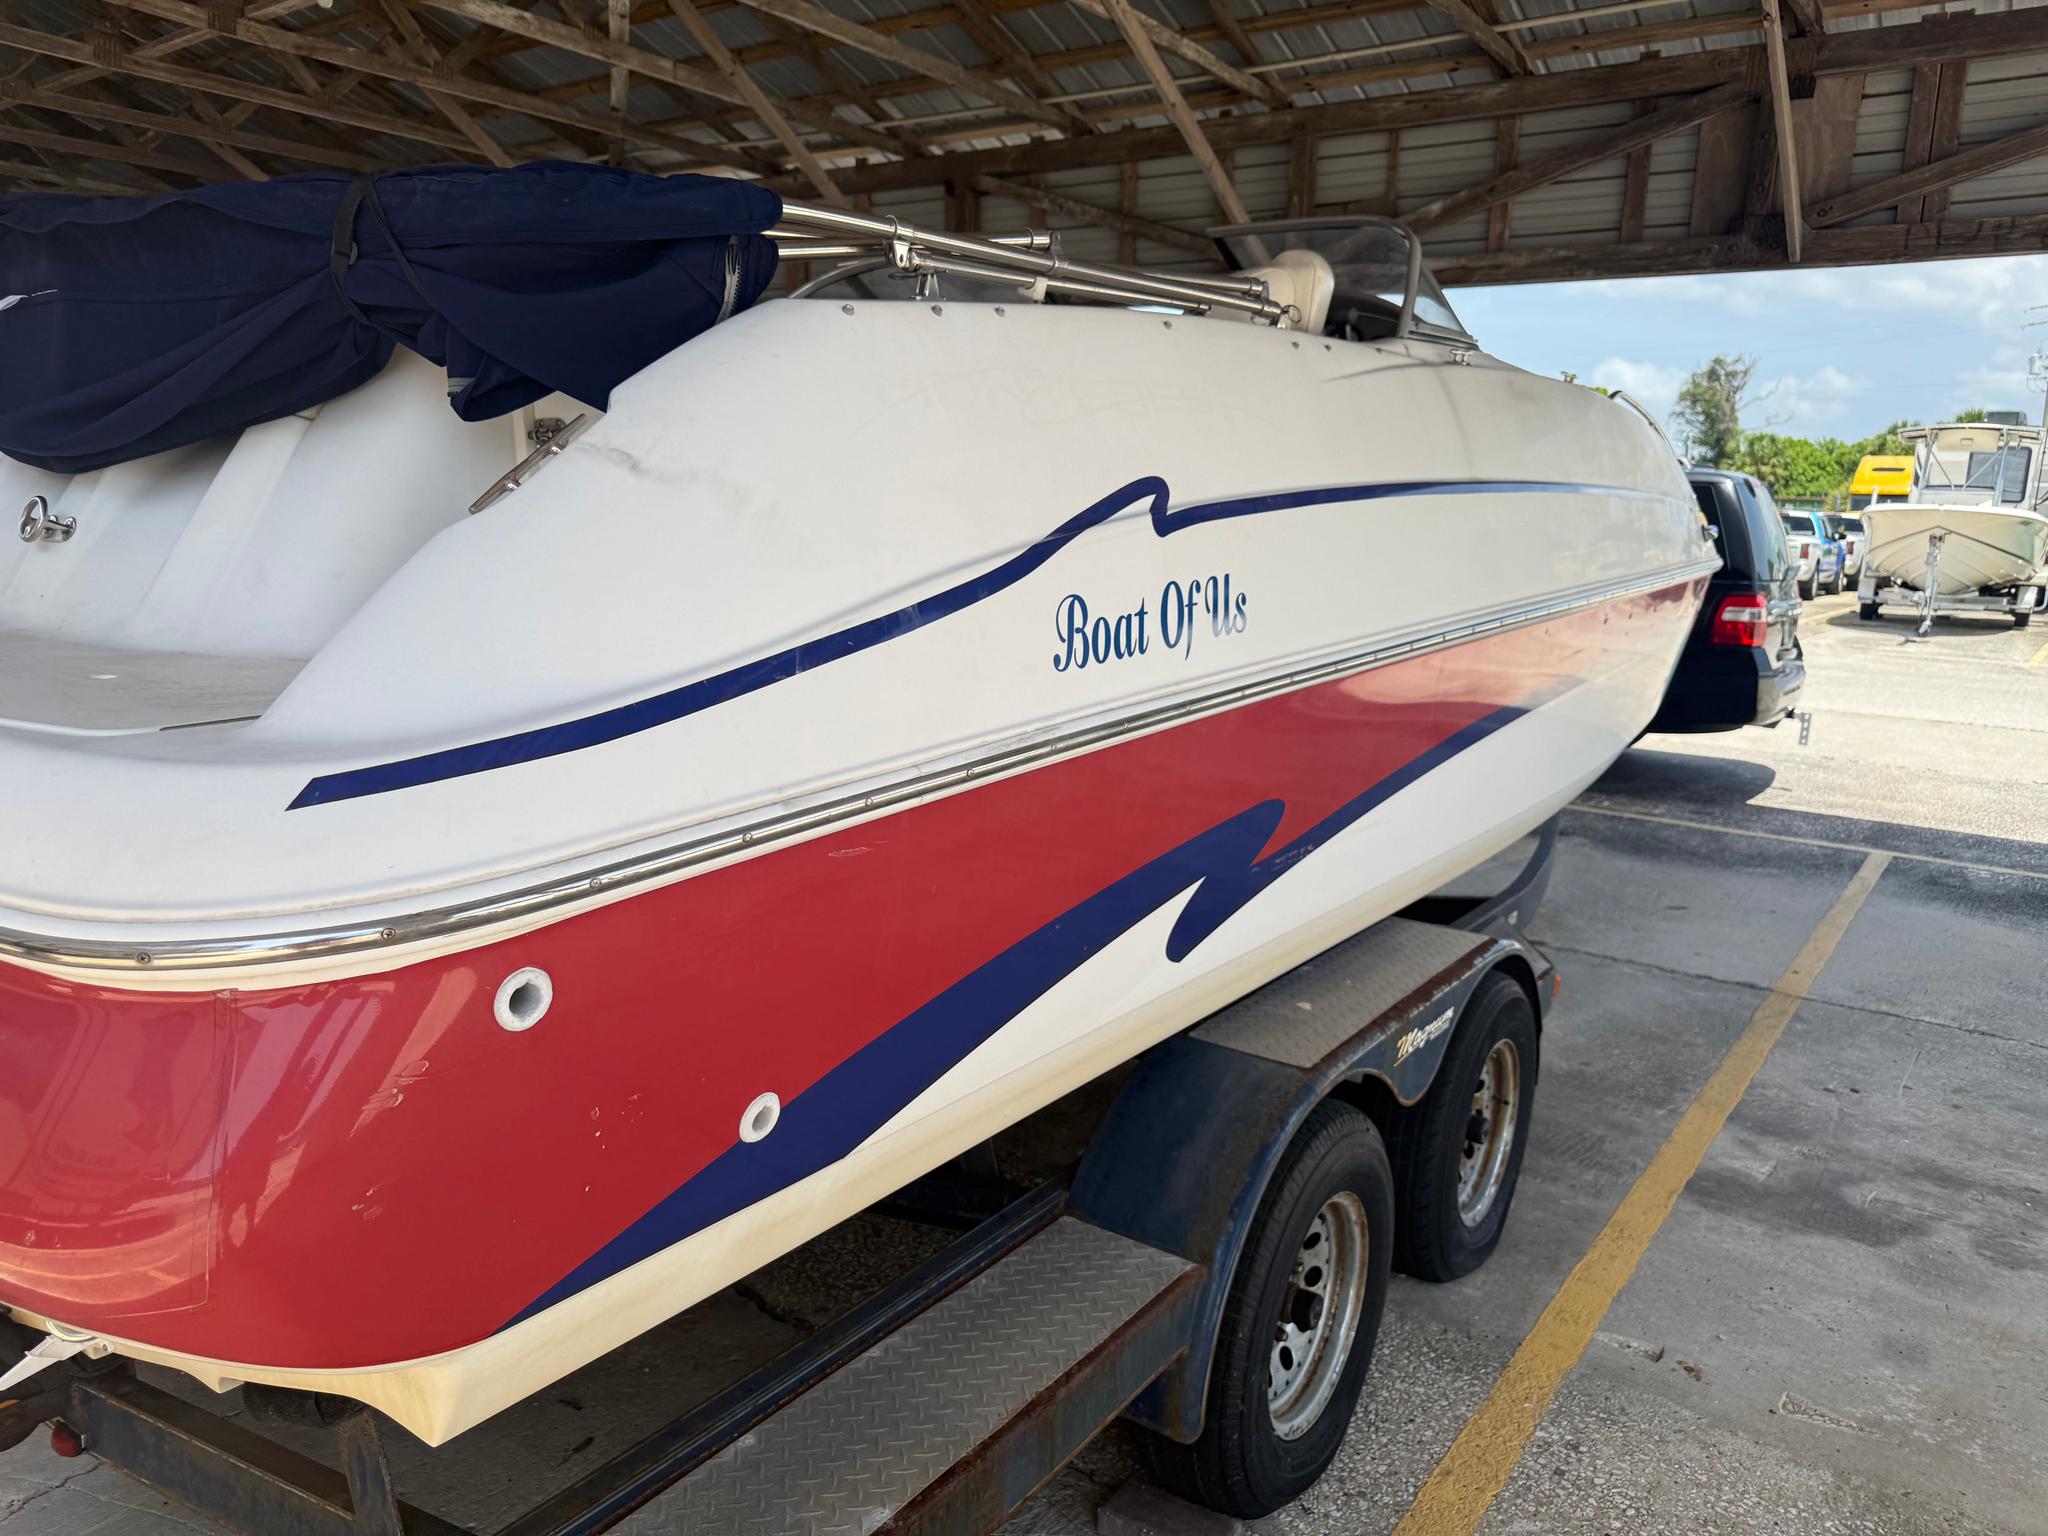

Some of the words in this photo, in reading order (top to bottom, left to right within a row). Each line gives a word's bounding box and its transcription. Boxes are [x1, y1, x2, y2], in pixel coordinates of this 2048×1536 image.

[1053, 594, 1149, 672] Boat
[1160, 580, 1200, 661] Of
[1204, 573, 1247, 637] Us
